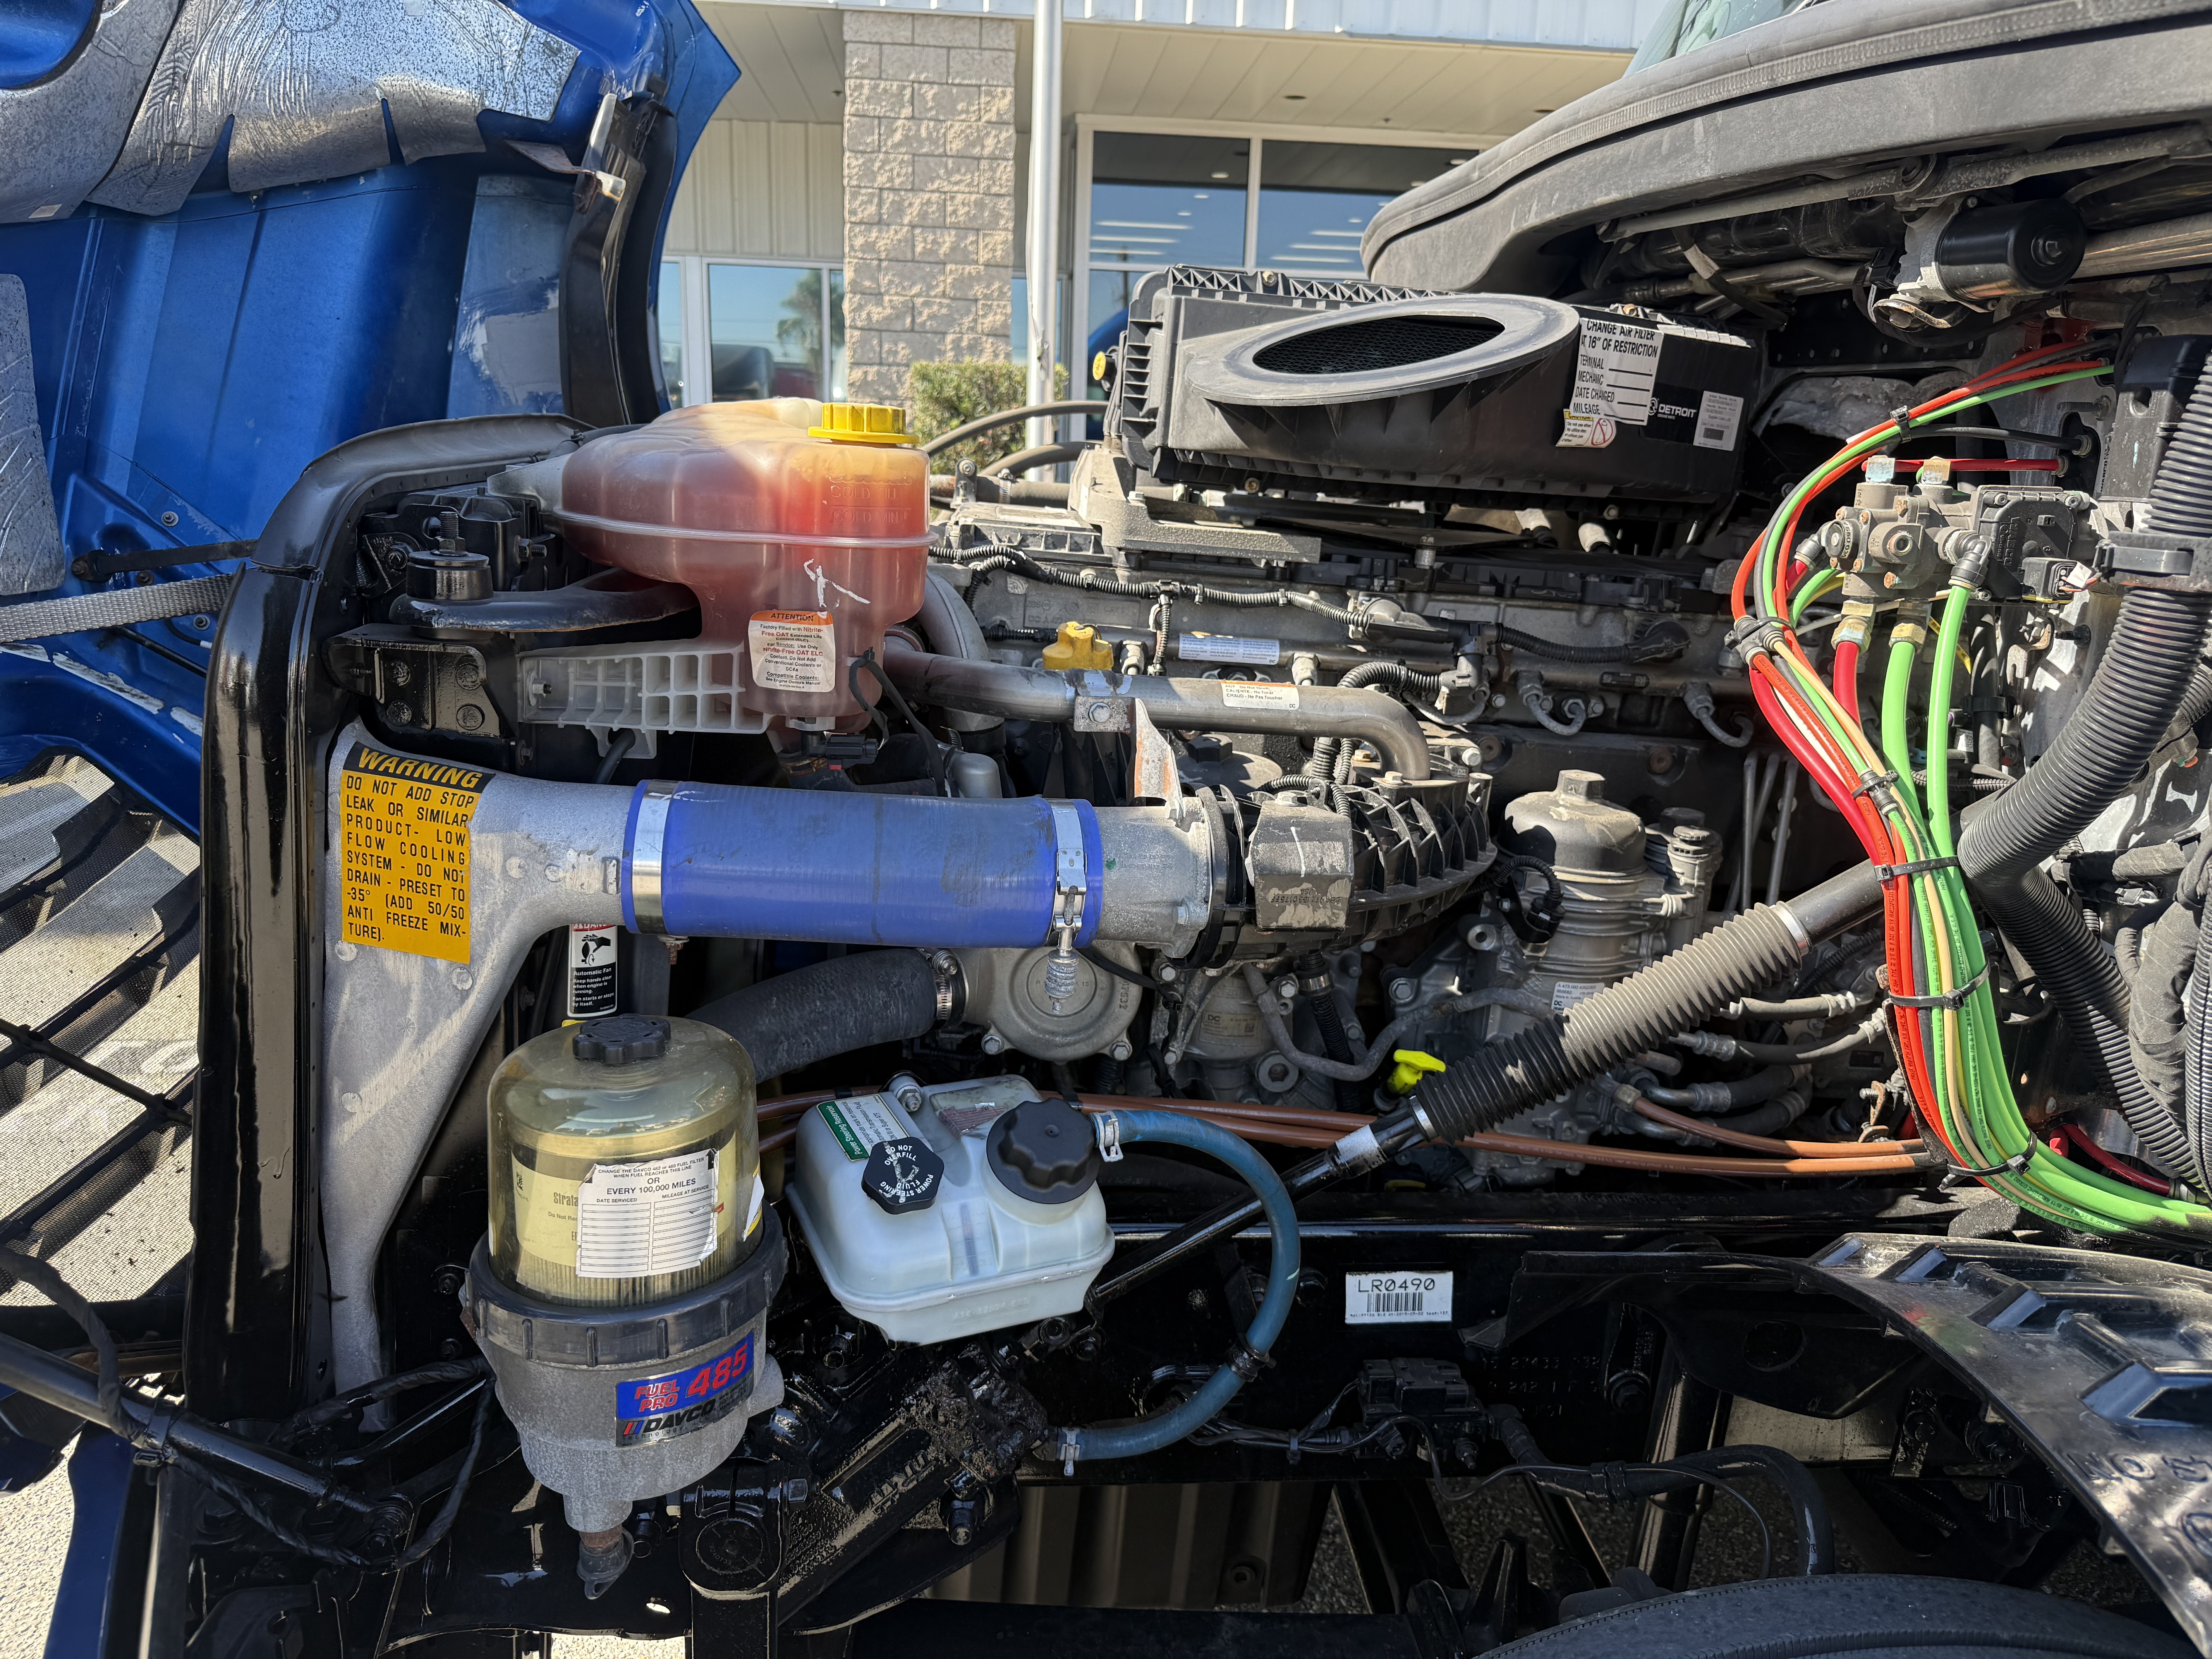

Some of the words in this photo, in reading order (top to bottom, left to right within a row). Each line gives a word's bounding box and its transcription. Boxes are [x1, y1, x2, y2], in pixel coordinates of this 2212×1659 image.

[1587, 320, 1617, 335] CHANGE
[1619, 326, 1632, 337] AIR
[1634, 328, 1655, 341] FILTER
[1581, 335, 1587, 347] AT
[1602, 338, 1612, 351] OF
[1613, 340, 1658, 358] RESTRICTION
[1580, 354, 1604, 369] TERMINAL
[1578, 370, 1604, 385] MECHANIC
[1575, 386, 1590, 399] DATE
[1591, 388, 1614, 403] CHANGED
[1573, 402, 1601, 415] MILEAGE
[1659, 404, 1697, 418] DETROIT
[771, 613, 813, 622] ATTENTION
[359, 747, 483, 788] WARNING
[347, 775, 362, 790] DO
[372, 779, 397, 796] NOT
[405, 786, 432, 802] ADD
[440, 792, 474, 809] STOP
[346, 794, 374, 812] LEAK
[388, 802, 403, 817] OR
[417, 807, 468, 828] SIMILAR
[347, 815, 419, 837] PRODUCT-
[436, 829, 465, 847] LOW
[347, 831, 385, 851] FLOW
[400, 842, 465, 865] COOLING
[347, 850, 392, 871] SYSTEM
[417, 863, 431, 878] DO
[443, 868, 465, 883] NOT
[347, 869, 381, 886] DRAIN
[400, 878, 442, 898] PRESET
[451, 887, 465, 902] TO
[386, 893, 412, 910] (ADD
[428, 900, 464, 920] 50/50
[348, 905, 373, 921] ANTI
[386, 912, 428, 931] FREEZE
[440, 922, 466, 937] MIX-
[349, 922, 384, 942] TURE).
[854, 1101, 863, 1110] Fluid
[826, 1106, 842, 1125] Reservoir
[852, 1118, 862, 1127] mark
[860, 1109, 876, 1129] Transmission
[879, 1117, 888, 1127] Super
[838, 1124, 853, 1142] Steering
[850, 1140, 863, 1155] Power
[884, 1152, 917, 1165] OVERFILL
[639, 1184, 670, 1193] 100,000
[672, 1178, 696, 1189] MILES
[691, 1185, 709, 1193] SERVICE
[880, 1182, 914, 1196] STEERING
[896, 1180, 920, 1189] FLUID
[915, 1174, 933, 1194] POWER
[1358, 1278, 1435, 1292] LR0490
[687, 1342, 748, 1397] 485
[635, 1379, 679, 1400] FUEL
[639, 1393, 678, 1412] PRO
[643, 1400, 716, 1432] DAVCO
